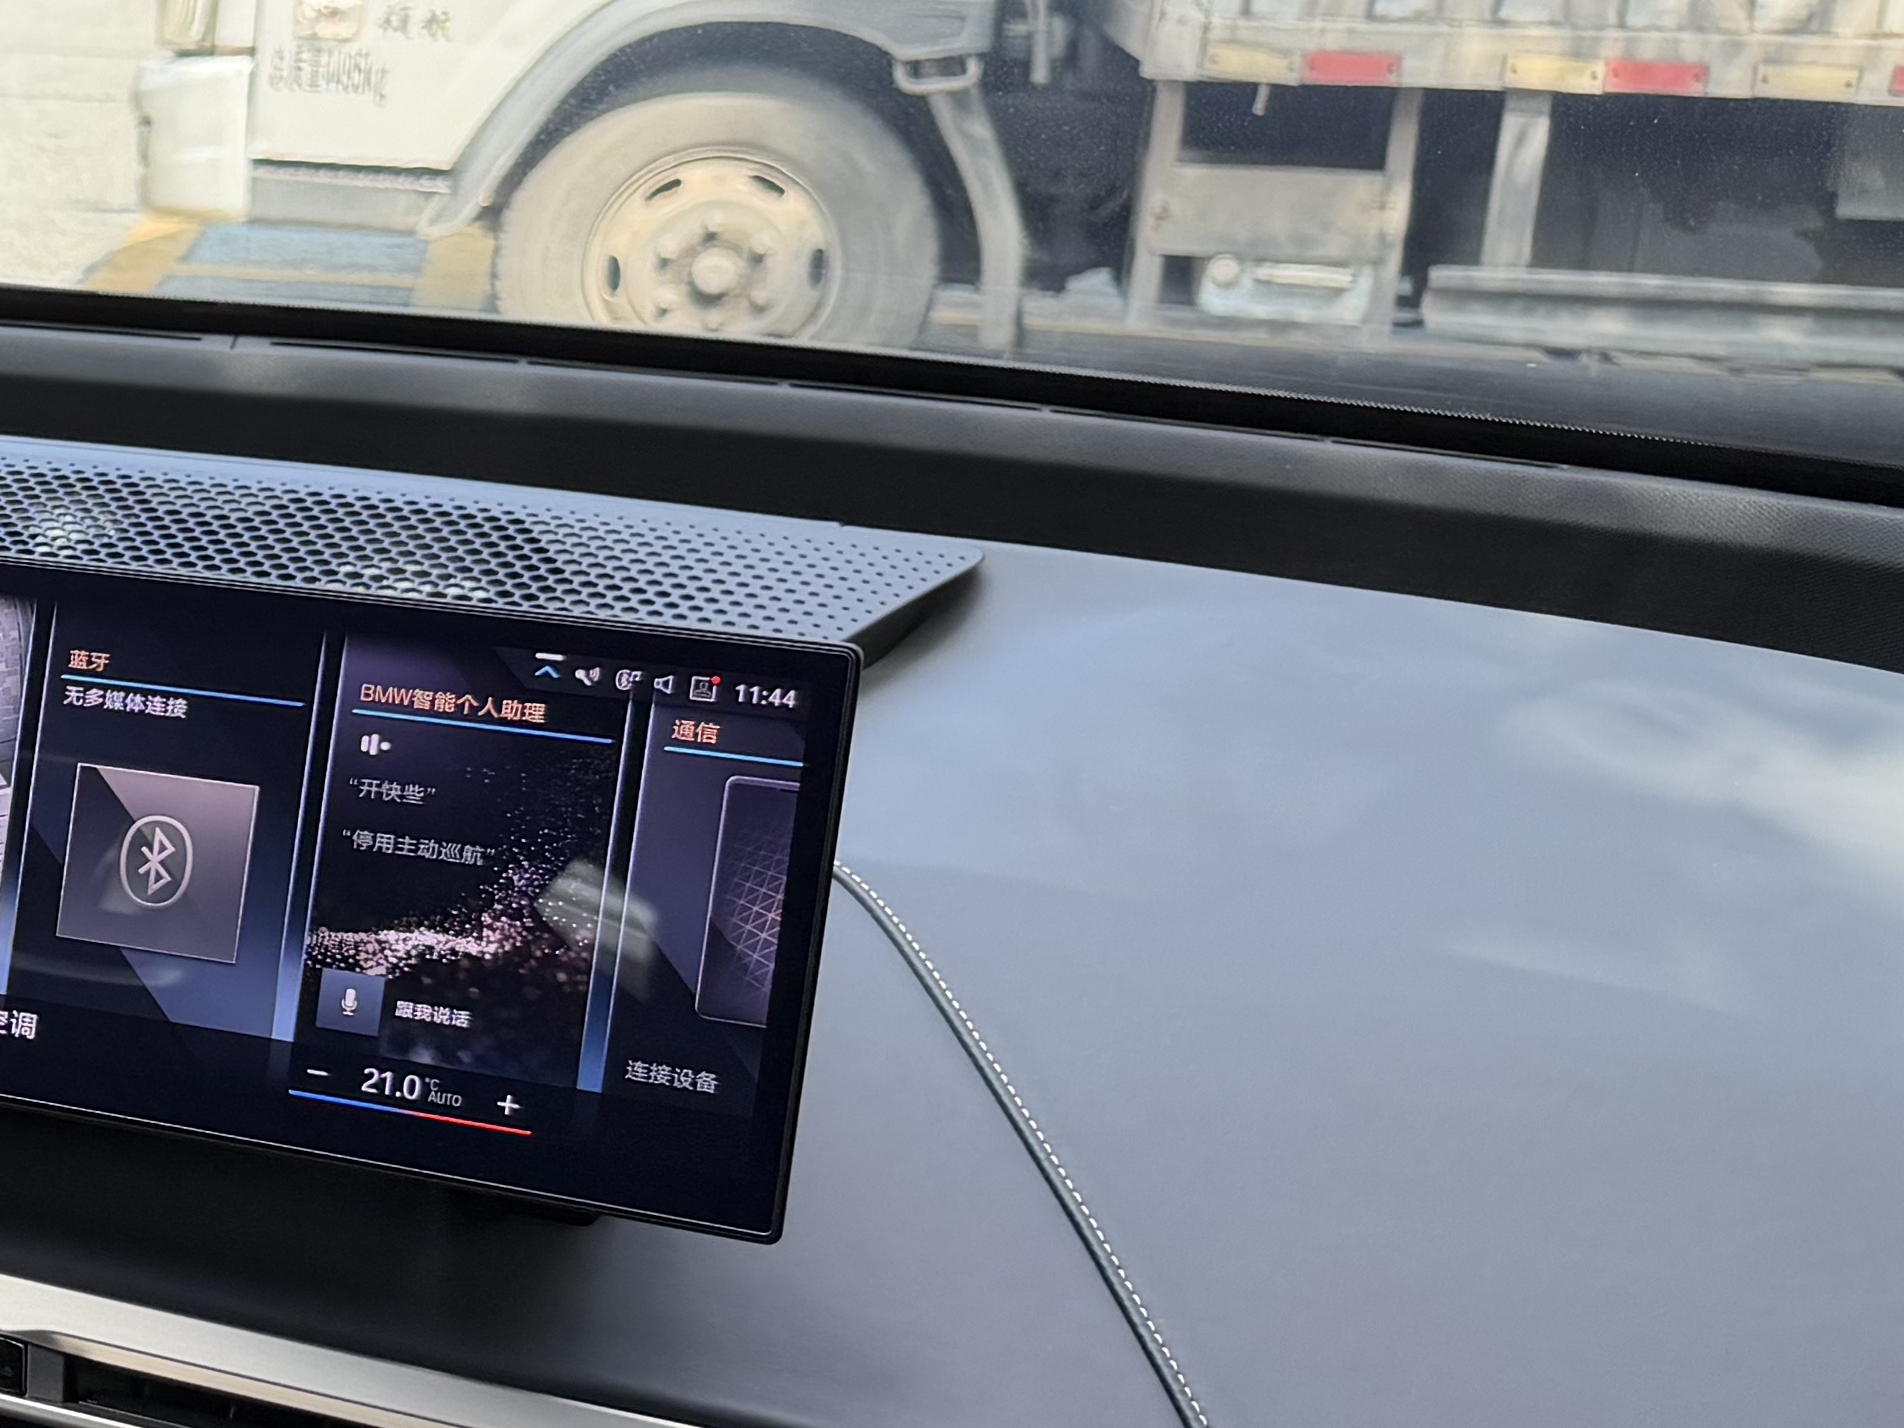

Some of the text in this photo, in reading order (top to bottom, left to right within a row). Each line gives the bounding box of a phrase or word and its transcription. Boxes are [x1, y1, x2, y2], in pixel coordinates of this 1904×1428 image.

[68, 649, 110, 673] 蓝牙
[63, 685, 189, 719] 无多媒体连接
[735, 684, 797, 709] 11:44
[671, 719, 721, 745] 通信
[394, 1000, 472, 1030] 跟我说话
[361, 1067, 423, 1101] 21.0
[427, 1090, 462, 1107] AUTO
[624, 1059, 720, 1095] 连接设备
